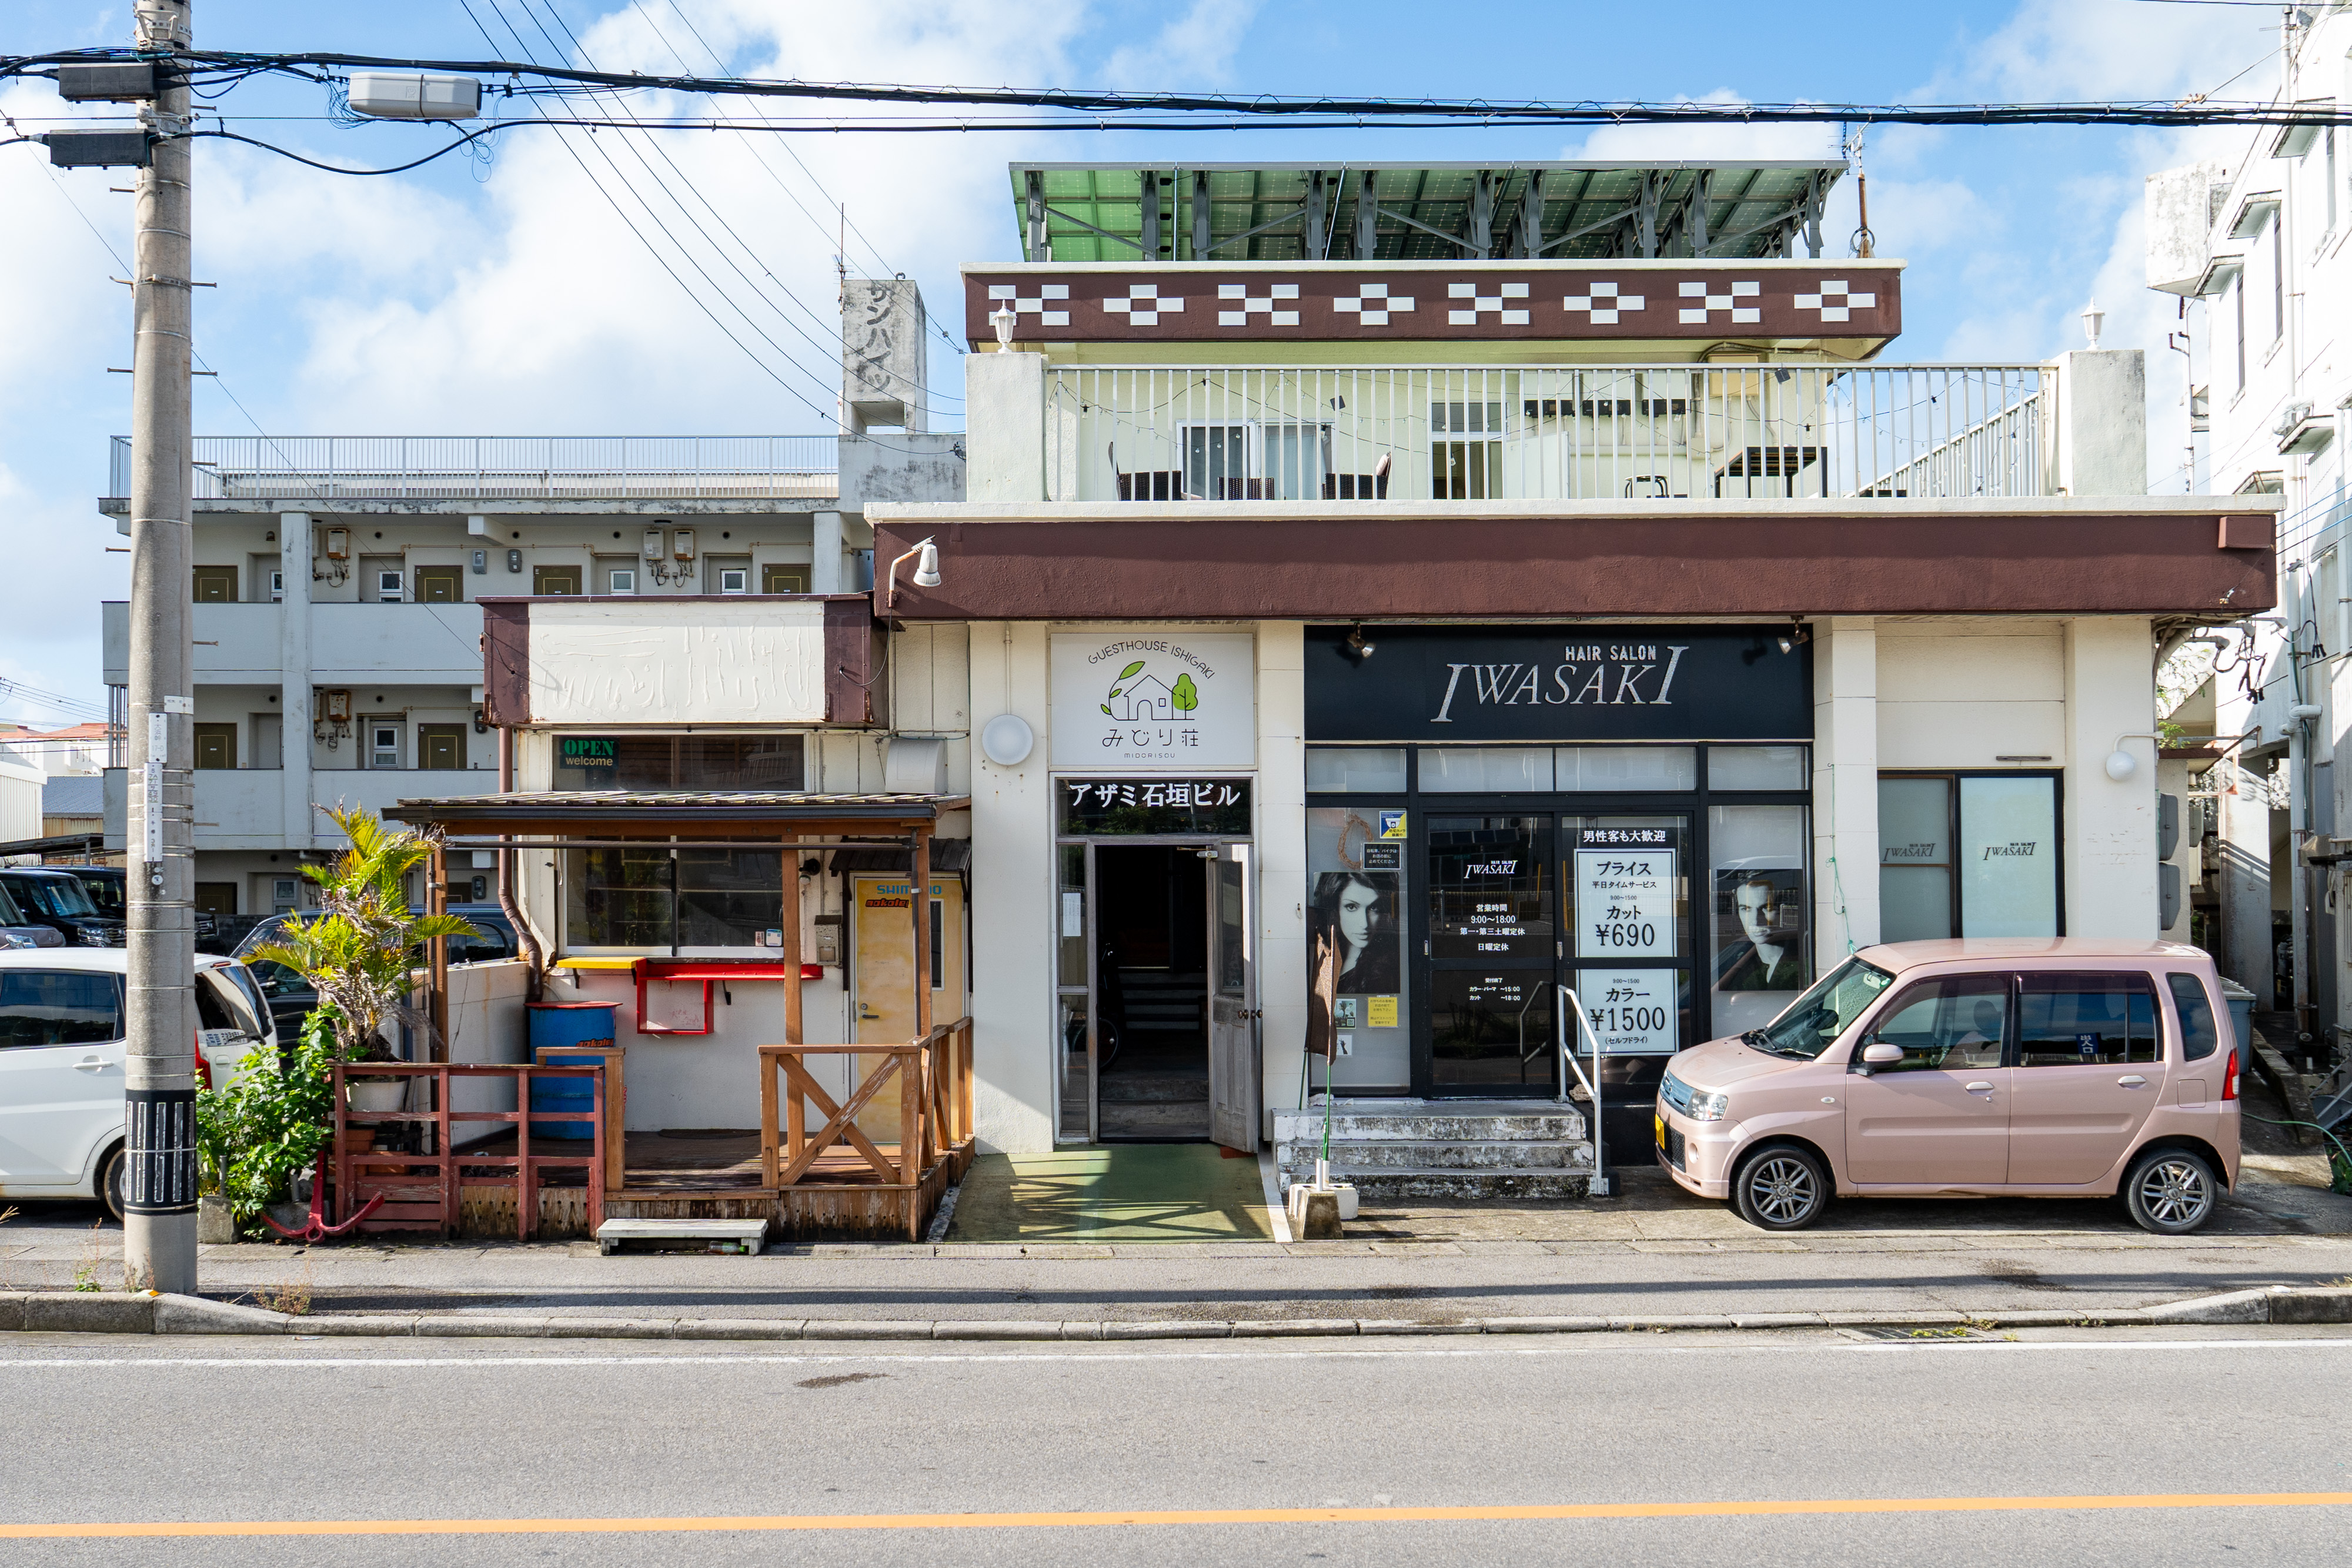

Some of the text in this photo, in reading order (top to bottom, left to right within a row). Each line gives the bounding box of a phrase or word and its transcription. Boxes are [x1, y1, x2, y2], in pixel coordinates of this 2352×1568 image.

[1088, 640, 1215, 679] GUESTHOUSE ISHIGAKI
[1565, 645, 1656, 661] HAIR SALON
[1430, 646, 1689, 723] IWASAKI
[1102, 728, 1198, 747] みどり荘
[564, 740, 614, 755] OPEN
[566, 755, 613, 766] welcome
[1069, 783, 1241, 808] アザミ石垣ビル
[1583, 830, 1666, 842] 男性客も大歓迎
[1882, 843, 1936, 861] IWASAKI
[1983, 842, 2037, 861] IWASAKI
[1464, 860, 1518, 878] IWASAKI
[1597, 861, 1652, 876] プライス
[1476, 904, 1508, 912] 営業時間
[1606, 905, 1641, 920] カット
[1459, 927, 1525, 935] 第一・第三土曜定休
[1595, 923, 1655, 947] ¥690
[1478, 943, 1509, 951] 日曜定休
[1606, 988, 1651, 1002] カラー
[1589, 1007, 1665, 1031] ¥1500
[1605, 1036, 1648, 1045] (セルフドライ)
[2080, 1035, 2094, 1054] 出入口
